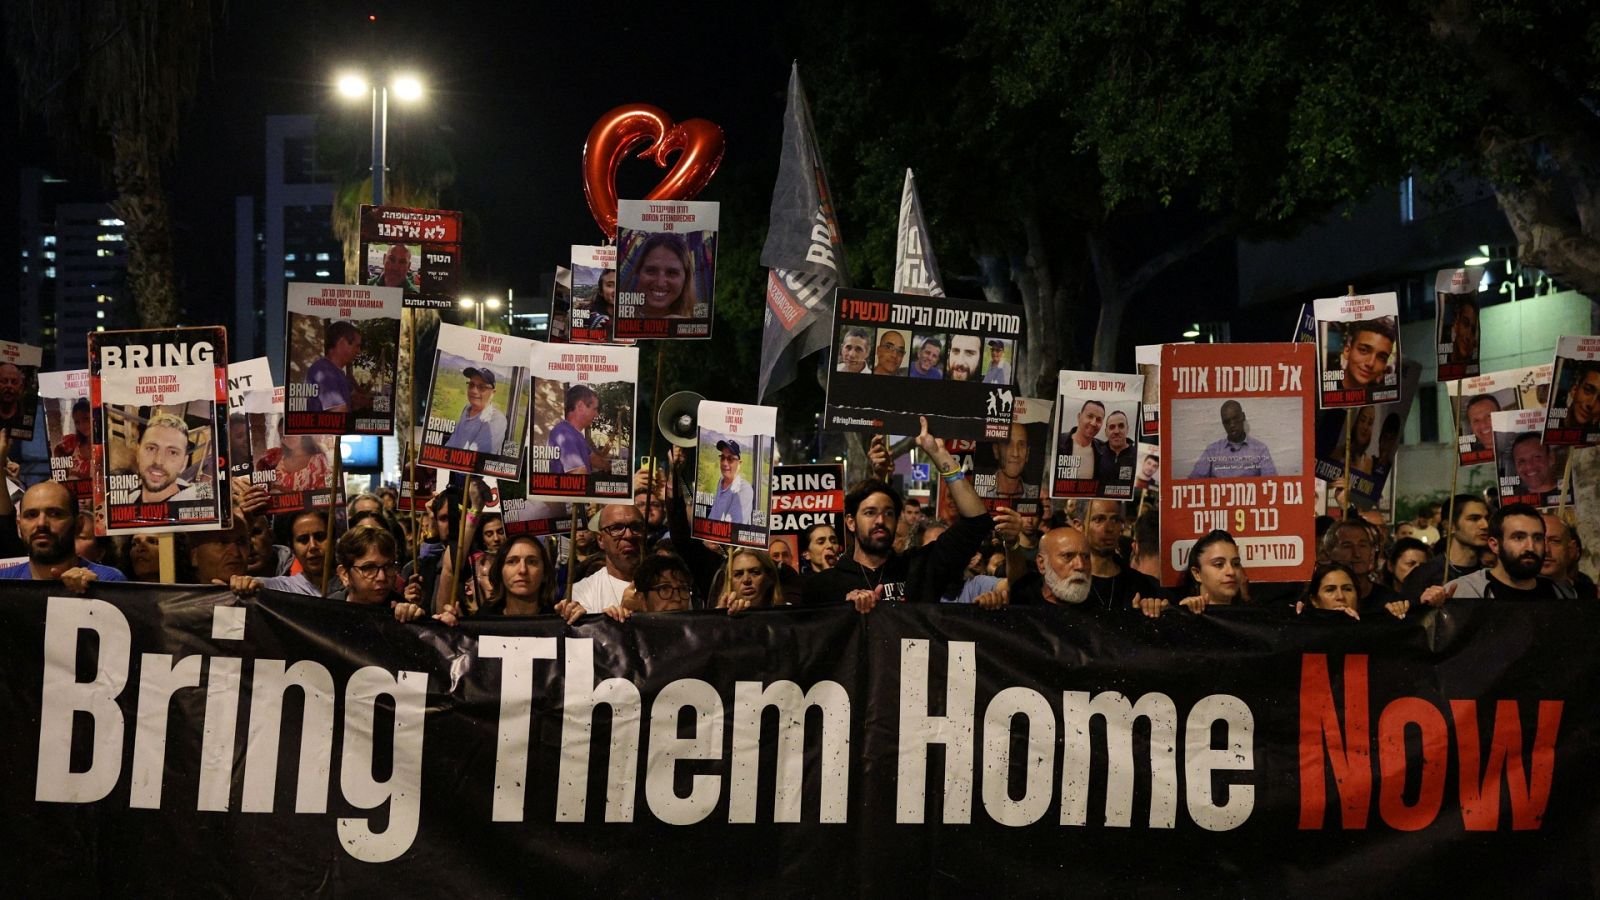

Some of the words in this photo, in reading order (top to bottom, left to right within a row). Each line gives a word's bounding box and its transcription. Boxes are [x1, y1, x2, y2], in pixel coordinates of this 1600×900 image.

[425, 214, 441, 222] רבע
[378, 223, 420, 238] איתנו
[425, 223, 446, 239] לא
[307, 297, 337, 307] FERNANDO
[339, 298, 357, 308] SIMON
[358, 299, 384, 309] MARMAN
[619, 292, 646, 306] BRING
[572, 309, 590, 319] BRING
[619, 306, 635, 318] HER
[891, 304, 933, 327] הביתה
[935, 308, 969, 330] אותם
[572, 318, 584, 328] HER
[971, 311, 1021, 334] מחזירים
[100, 341, 215, 369] BRING
[548, 362, 575, 371] FERNANDO
[576, 363, 593, 372] SIMON
[594, 364, 619, 373] MARMAN
[577, 372, 589, 381] (60)
[1172, 366, 1209, 393] אותי
[1215, 365, 1272, 393] תשכחו
[1278, 363, 1303, 391] אל
[1323, 369, 1345, 381] BRING
[136, 385, 157, 394] ELKANA
[158, 384, 180, 393] BOHBOT
[289, 383, 319, 397] BRING
[1077, 379, 1097, 391] שרעבי
[1113, 381, 1126, 392] אלי
[1323, 380, 1337, 392] HIM
[152, 394, 164, 403] (34)
[289, 398, 308, 411] HIM
[427, 416, 456, 433] BRING
[425, 431, 443, 445] HIM
[986, 430, 1008, 439] HOME!
[423, 446, 448, 462] HOME
[449, 449, 478, 465] NOW!
[532, 445, 560, 460] BRING
[51, 457, 74, 470] BRING
[532, 459, 550, 473] HIM
[1058, 454, 1080, 466] BRING
[52, 469, 67, 482] HER
[252, 470, 276, 483] BRING
[1057, 466, 1078, 479] THEM
[109, 475, 139, 491] BRING
[532, 475, 558, 489] HOME
[559, 476, 586, 491] NOW!
[772, 473, 836, 490] BRING
[975, 474, 996, 486] BRING
[1500, 476, 1520, 486] BRING
[110, 490, 129, 504] HIM
[1172, 484, 1206, 509] בבית
[1210, 482, 1257, 508] מחכים
[1262, 480, 1277, 505] לי
[1283, 481, 1303, 505] גם
[1501, 485, 1514, 495] HIM
[503, 499, 525, 512] BRING
[695, 492, 714, 506] BRING
[772, 495, 835, 510] TSACHI
[111, 506, 138, 521] HOME
[140, 504, 170, 519] NOW!
[772, 512, 836, 531] BACK!
[1235, 509, 1246, 532] 9
[1250, 508, 1280, 532] כבר
[1246, 543, 1296, 561] מחזירים
[35, 596, 429, 863] Bring
[477, 635, 851, 825] Them
[896, 638, 1255, 832] Home
[1297, 653, 1565, 832] Now
